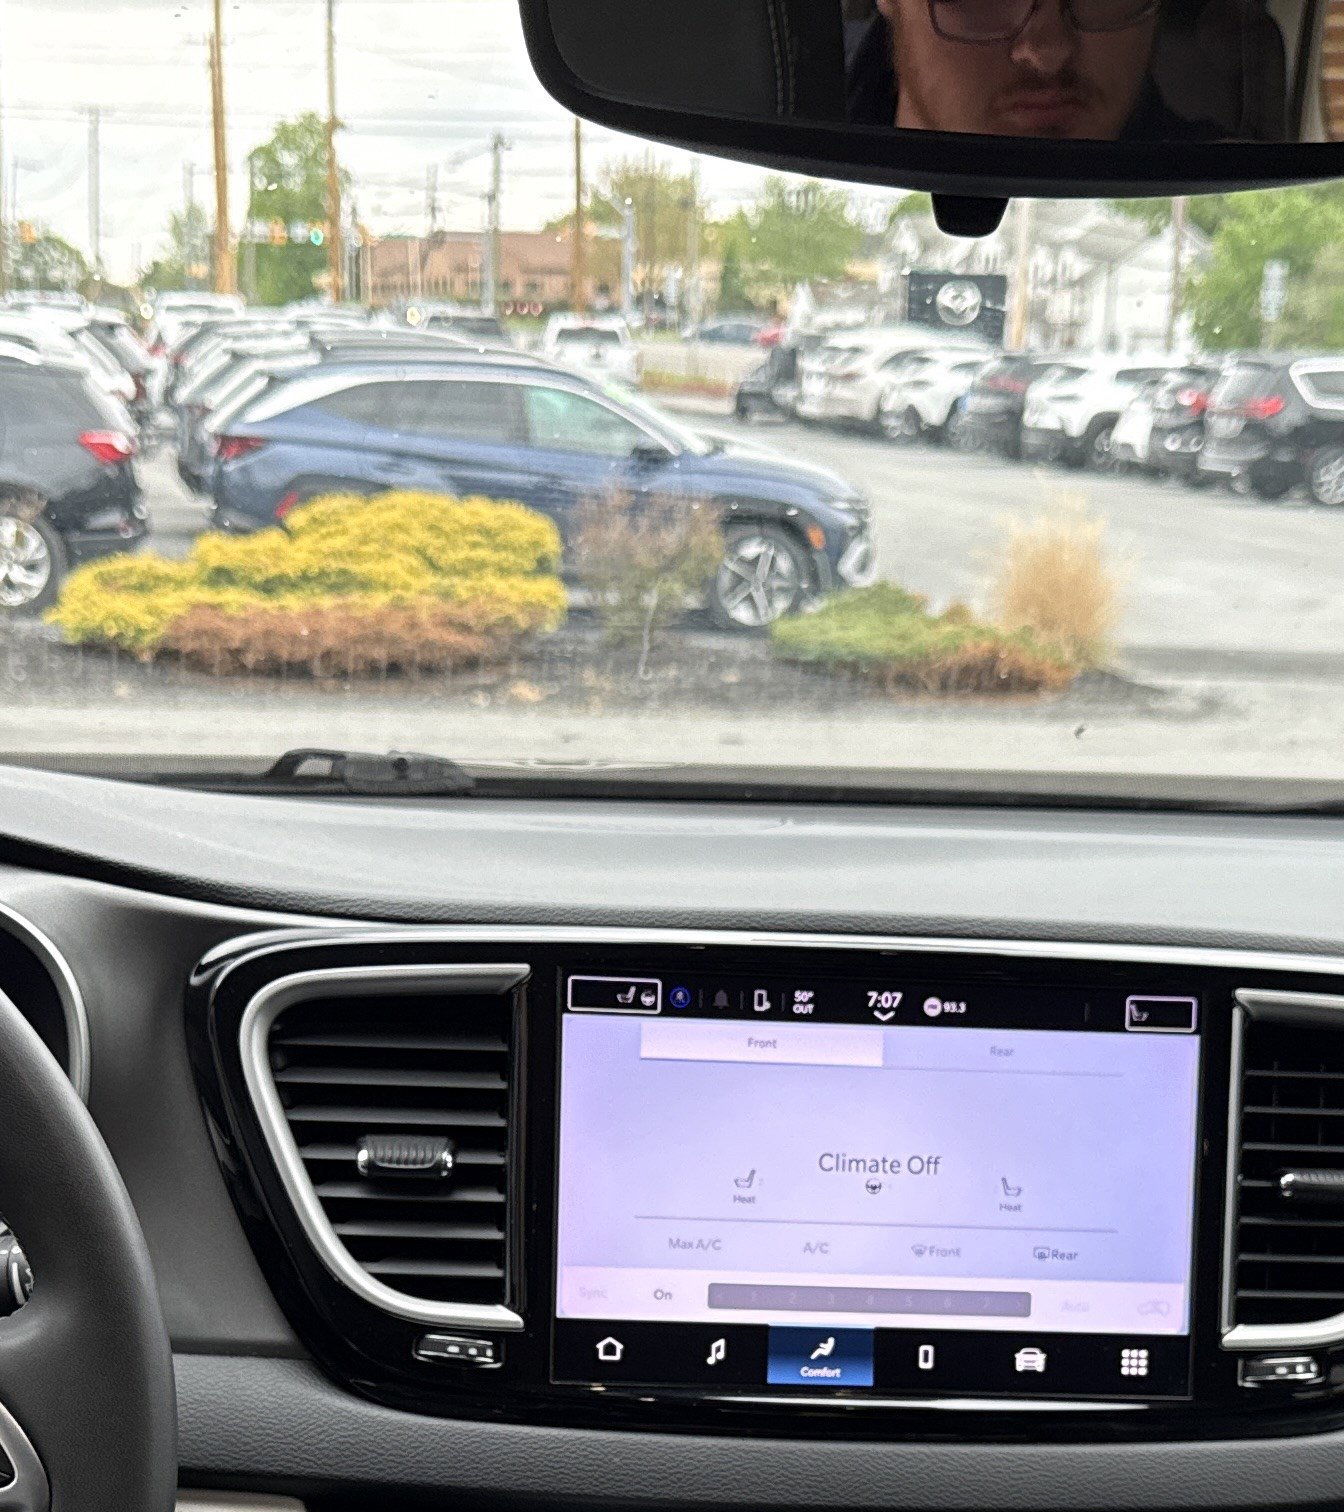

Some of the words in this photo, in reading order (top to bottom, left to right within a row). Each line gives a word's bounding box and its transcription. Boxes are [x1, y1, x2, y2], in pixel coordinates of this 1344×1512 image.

[866, 991, 903, 1008] 7:07
[792, 1004, 815, 1015] OUT
[747, 1037, 777, 1049] Front
[817, 1152, 901, 1175] Climate
[907, 1156, 943, 1175] Off
[733, 1194, 756, 1205] Heat
[999, 1203, 1023, 1213] Heat
[668, 1238, 694, 1250] Max
[696, 1238, 723, 1251] A/C
[803, 1241, 830, 1255] A/C
[929, 1246, 961, 1258] Front
[1051, 1249, 1079, 1261] Rear
[653, 1288, 672, 1301] On
[800, 1366, 841, 1379] Comfort
